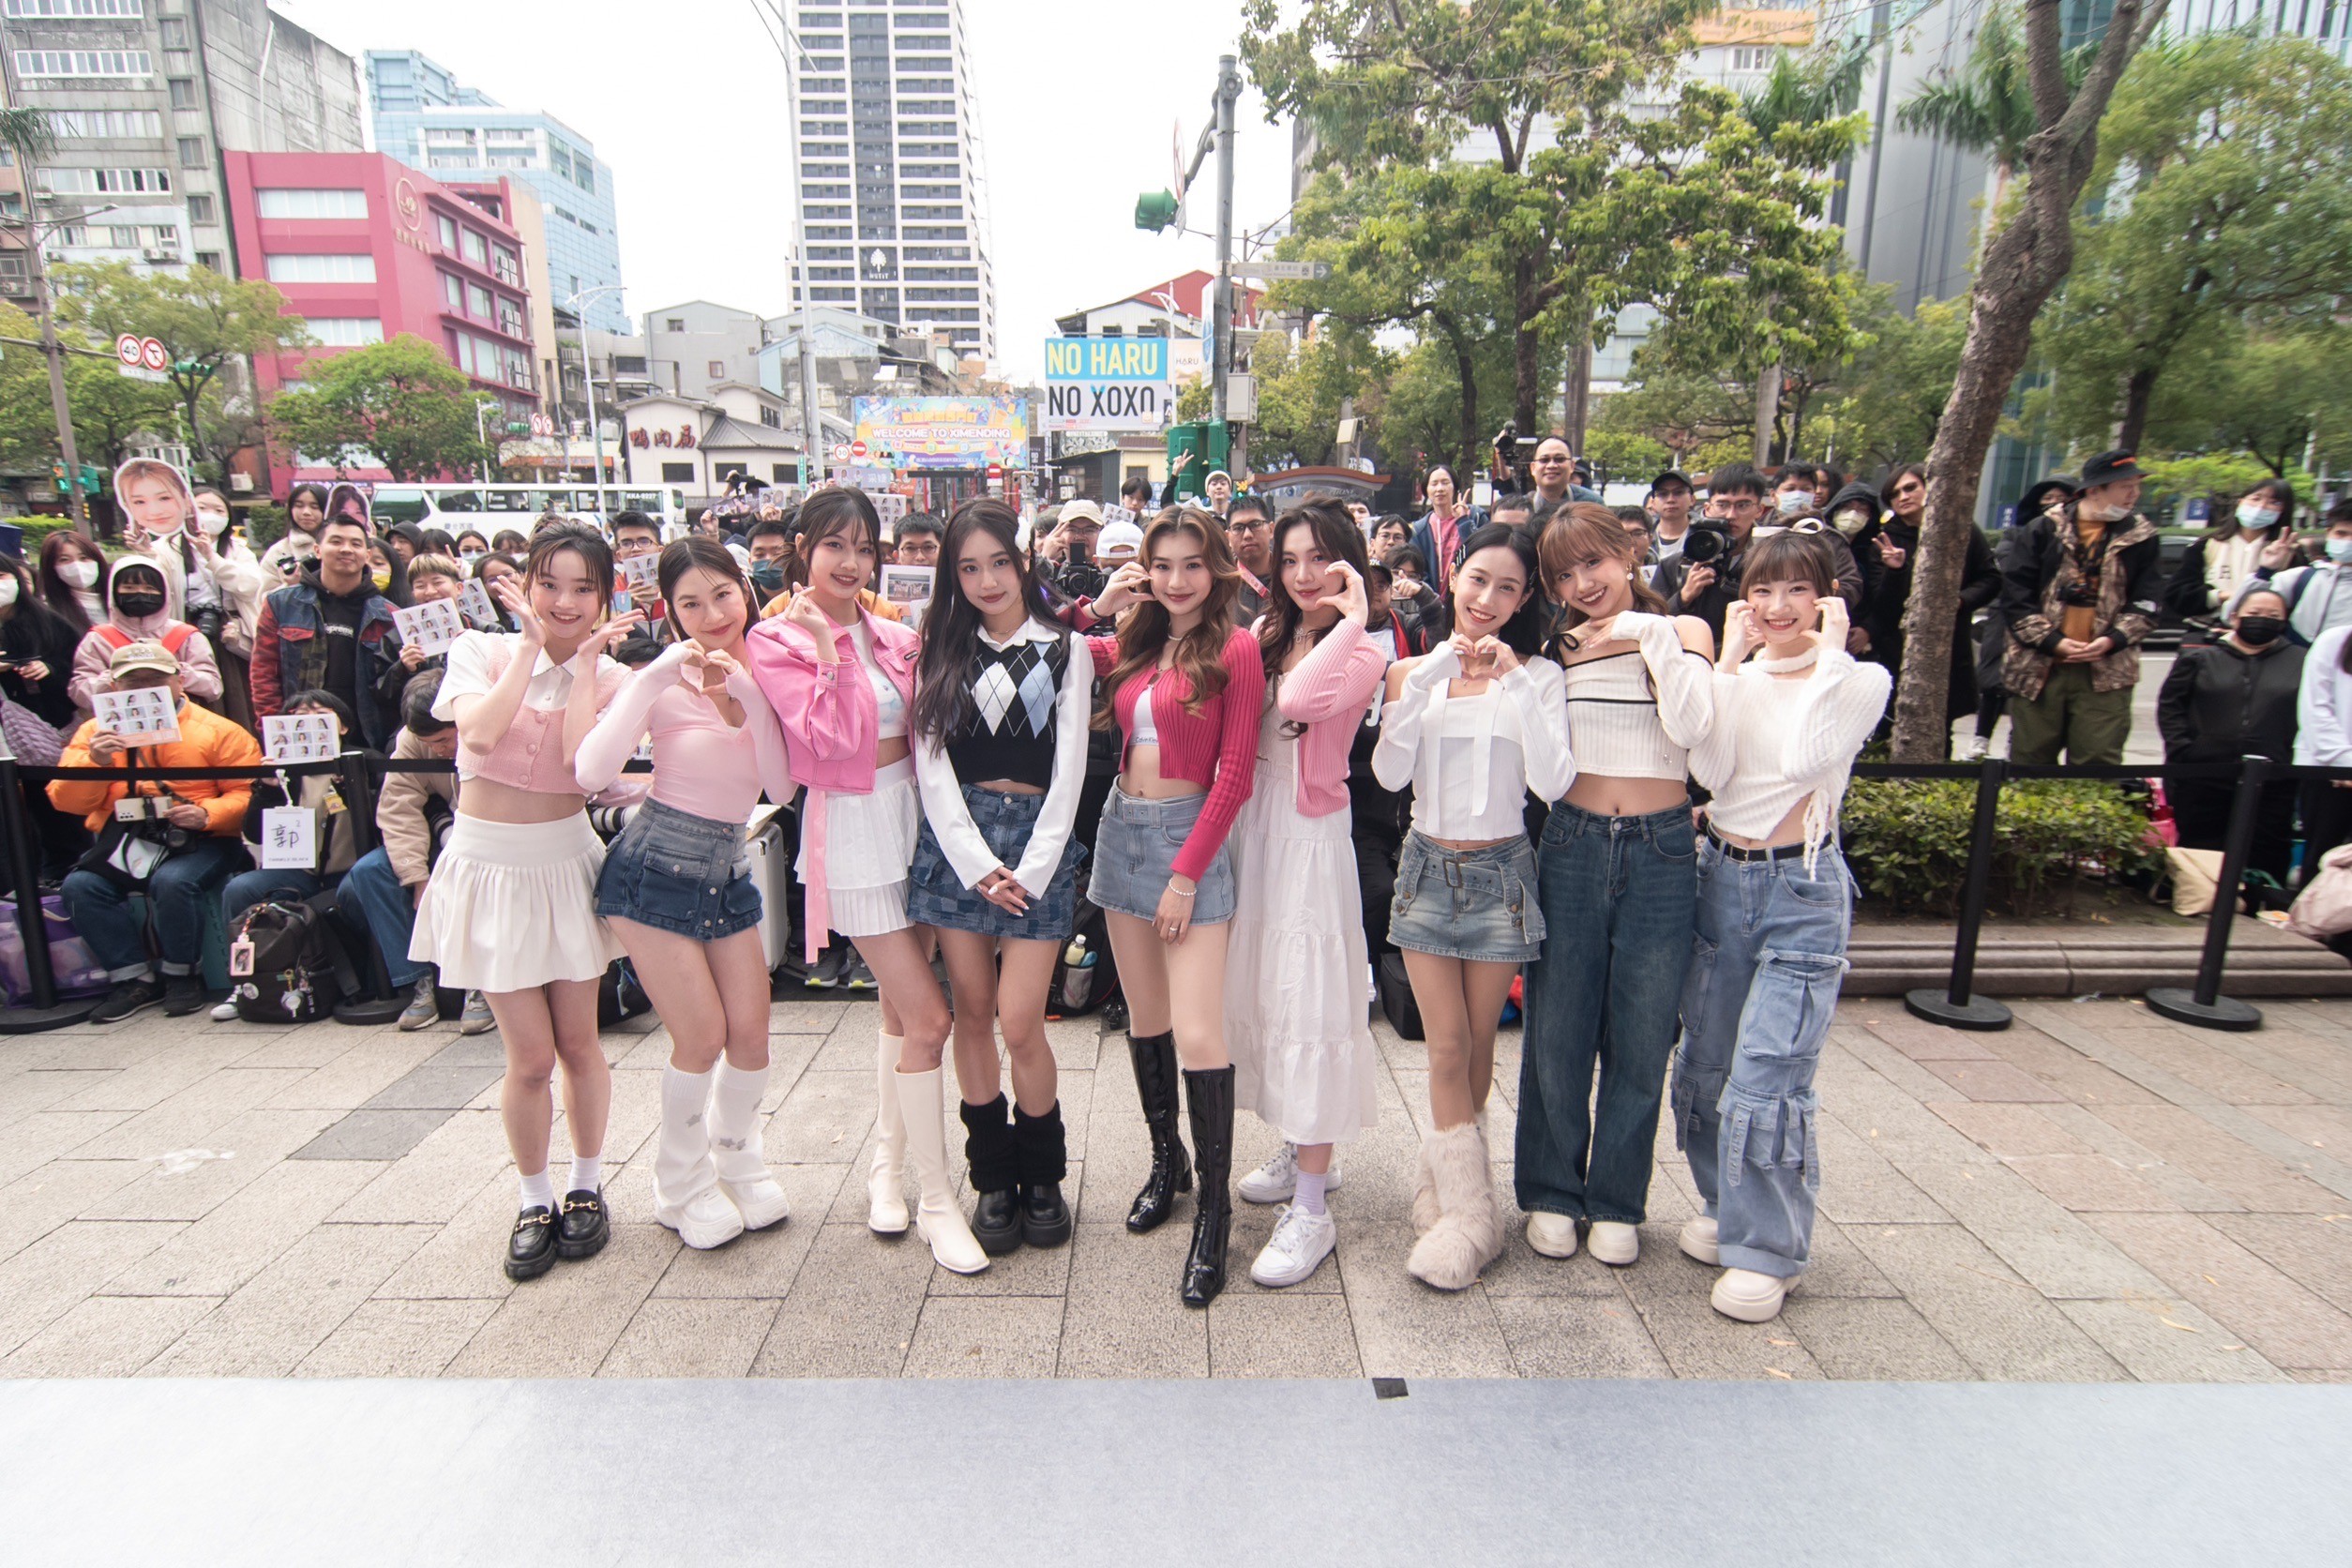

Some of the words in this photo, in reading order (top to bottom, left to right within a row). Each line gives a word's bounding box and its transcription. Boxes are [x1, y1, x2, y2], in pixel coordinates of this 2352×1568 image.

[124, 345, 138, 356] 40
[1048, 342, 1081, 375] NO
[1091, 342, 1158, 375] HARU
[1048, 385, 1081, 416] NO
[1090, 384, 1154, 416] XOXO
[872, 428, 928, 439] WELCOME
[931, 428, 947, 439] TO
[950, 428, 1011, 439] XIMENDING
